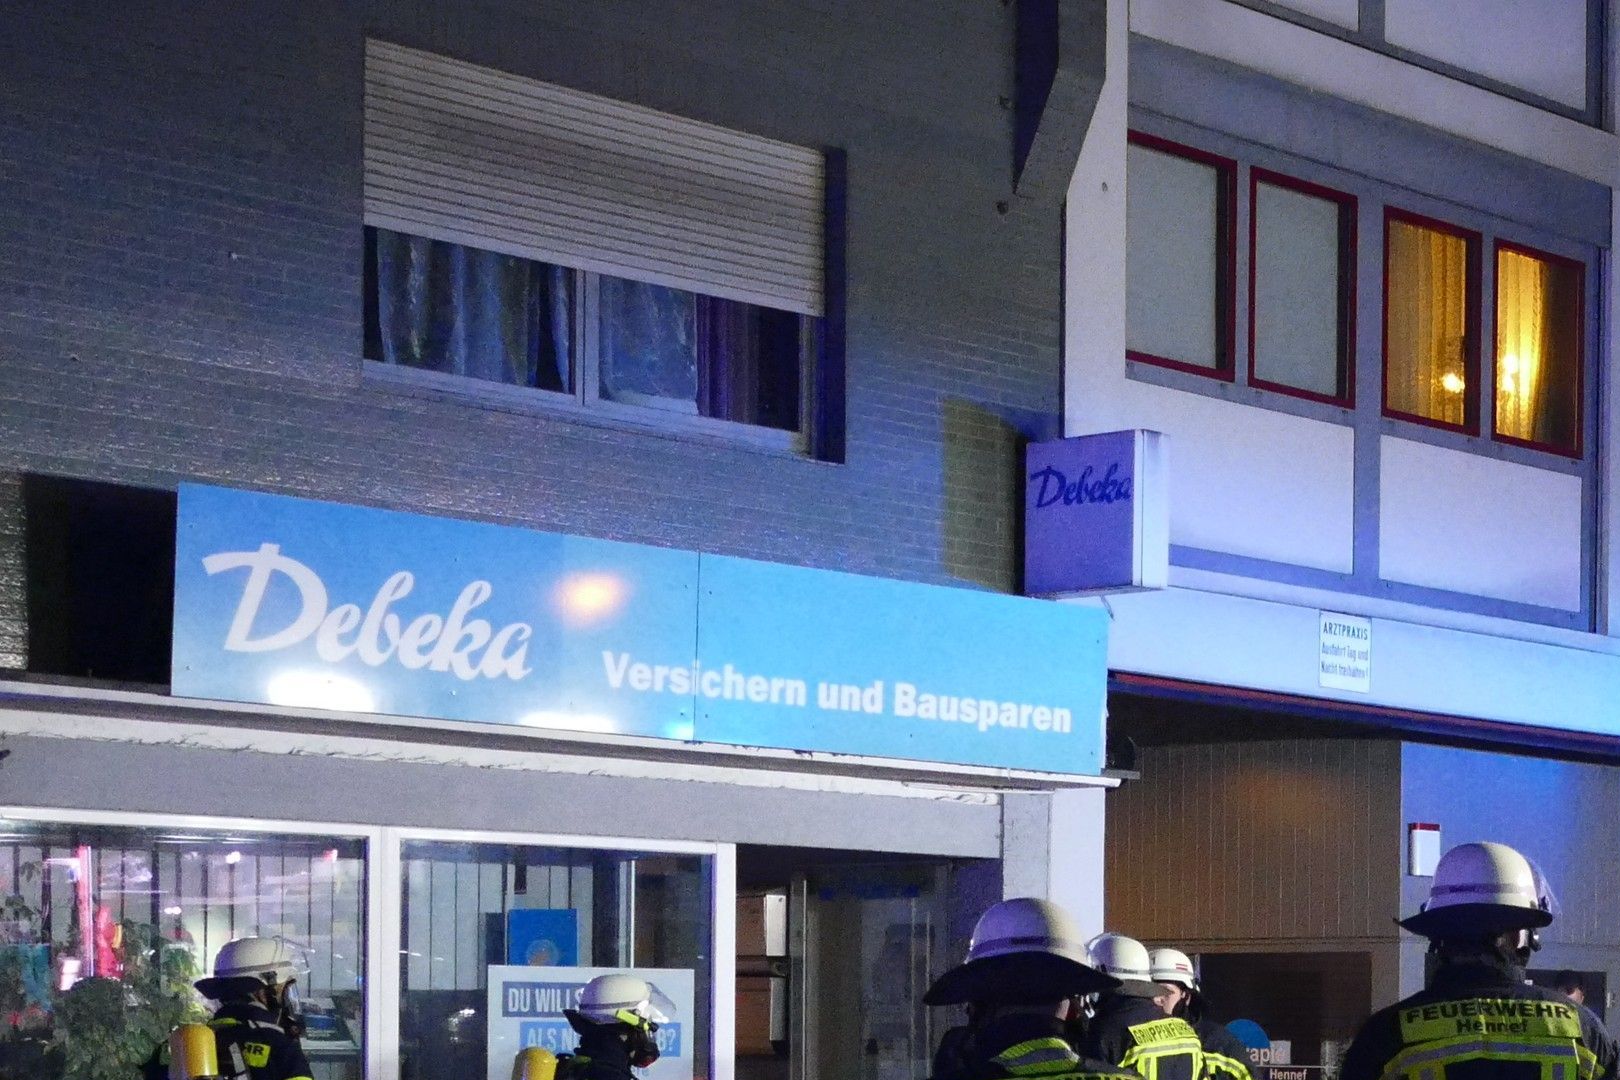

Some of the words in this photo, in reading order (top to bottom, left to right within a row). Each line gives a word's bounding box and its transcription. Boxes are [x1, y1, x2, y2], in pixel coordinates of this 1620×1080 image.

[1030, 463, 1132, 508] Debeka
[202, 543, 533, 681] Debeka
[1323, 621, 1368, 641] ARZTPRAXIS
[601, 650, 806, 707] Versichern
[817, 680, 884, 714] und
[893, 682, 1072, 734] Bausparen
[508, 987, 530, 1013] DU
[1406, 1001, 1572, 1024] FEUERWEHR
[1456, 1016, 1528, 1034] Hennef
[1270, 1068, 1307, 1080] Hennef
